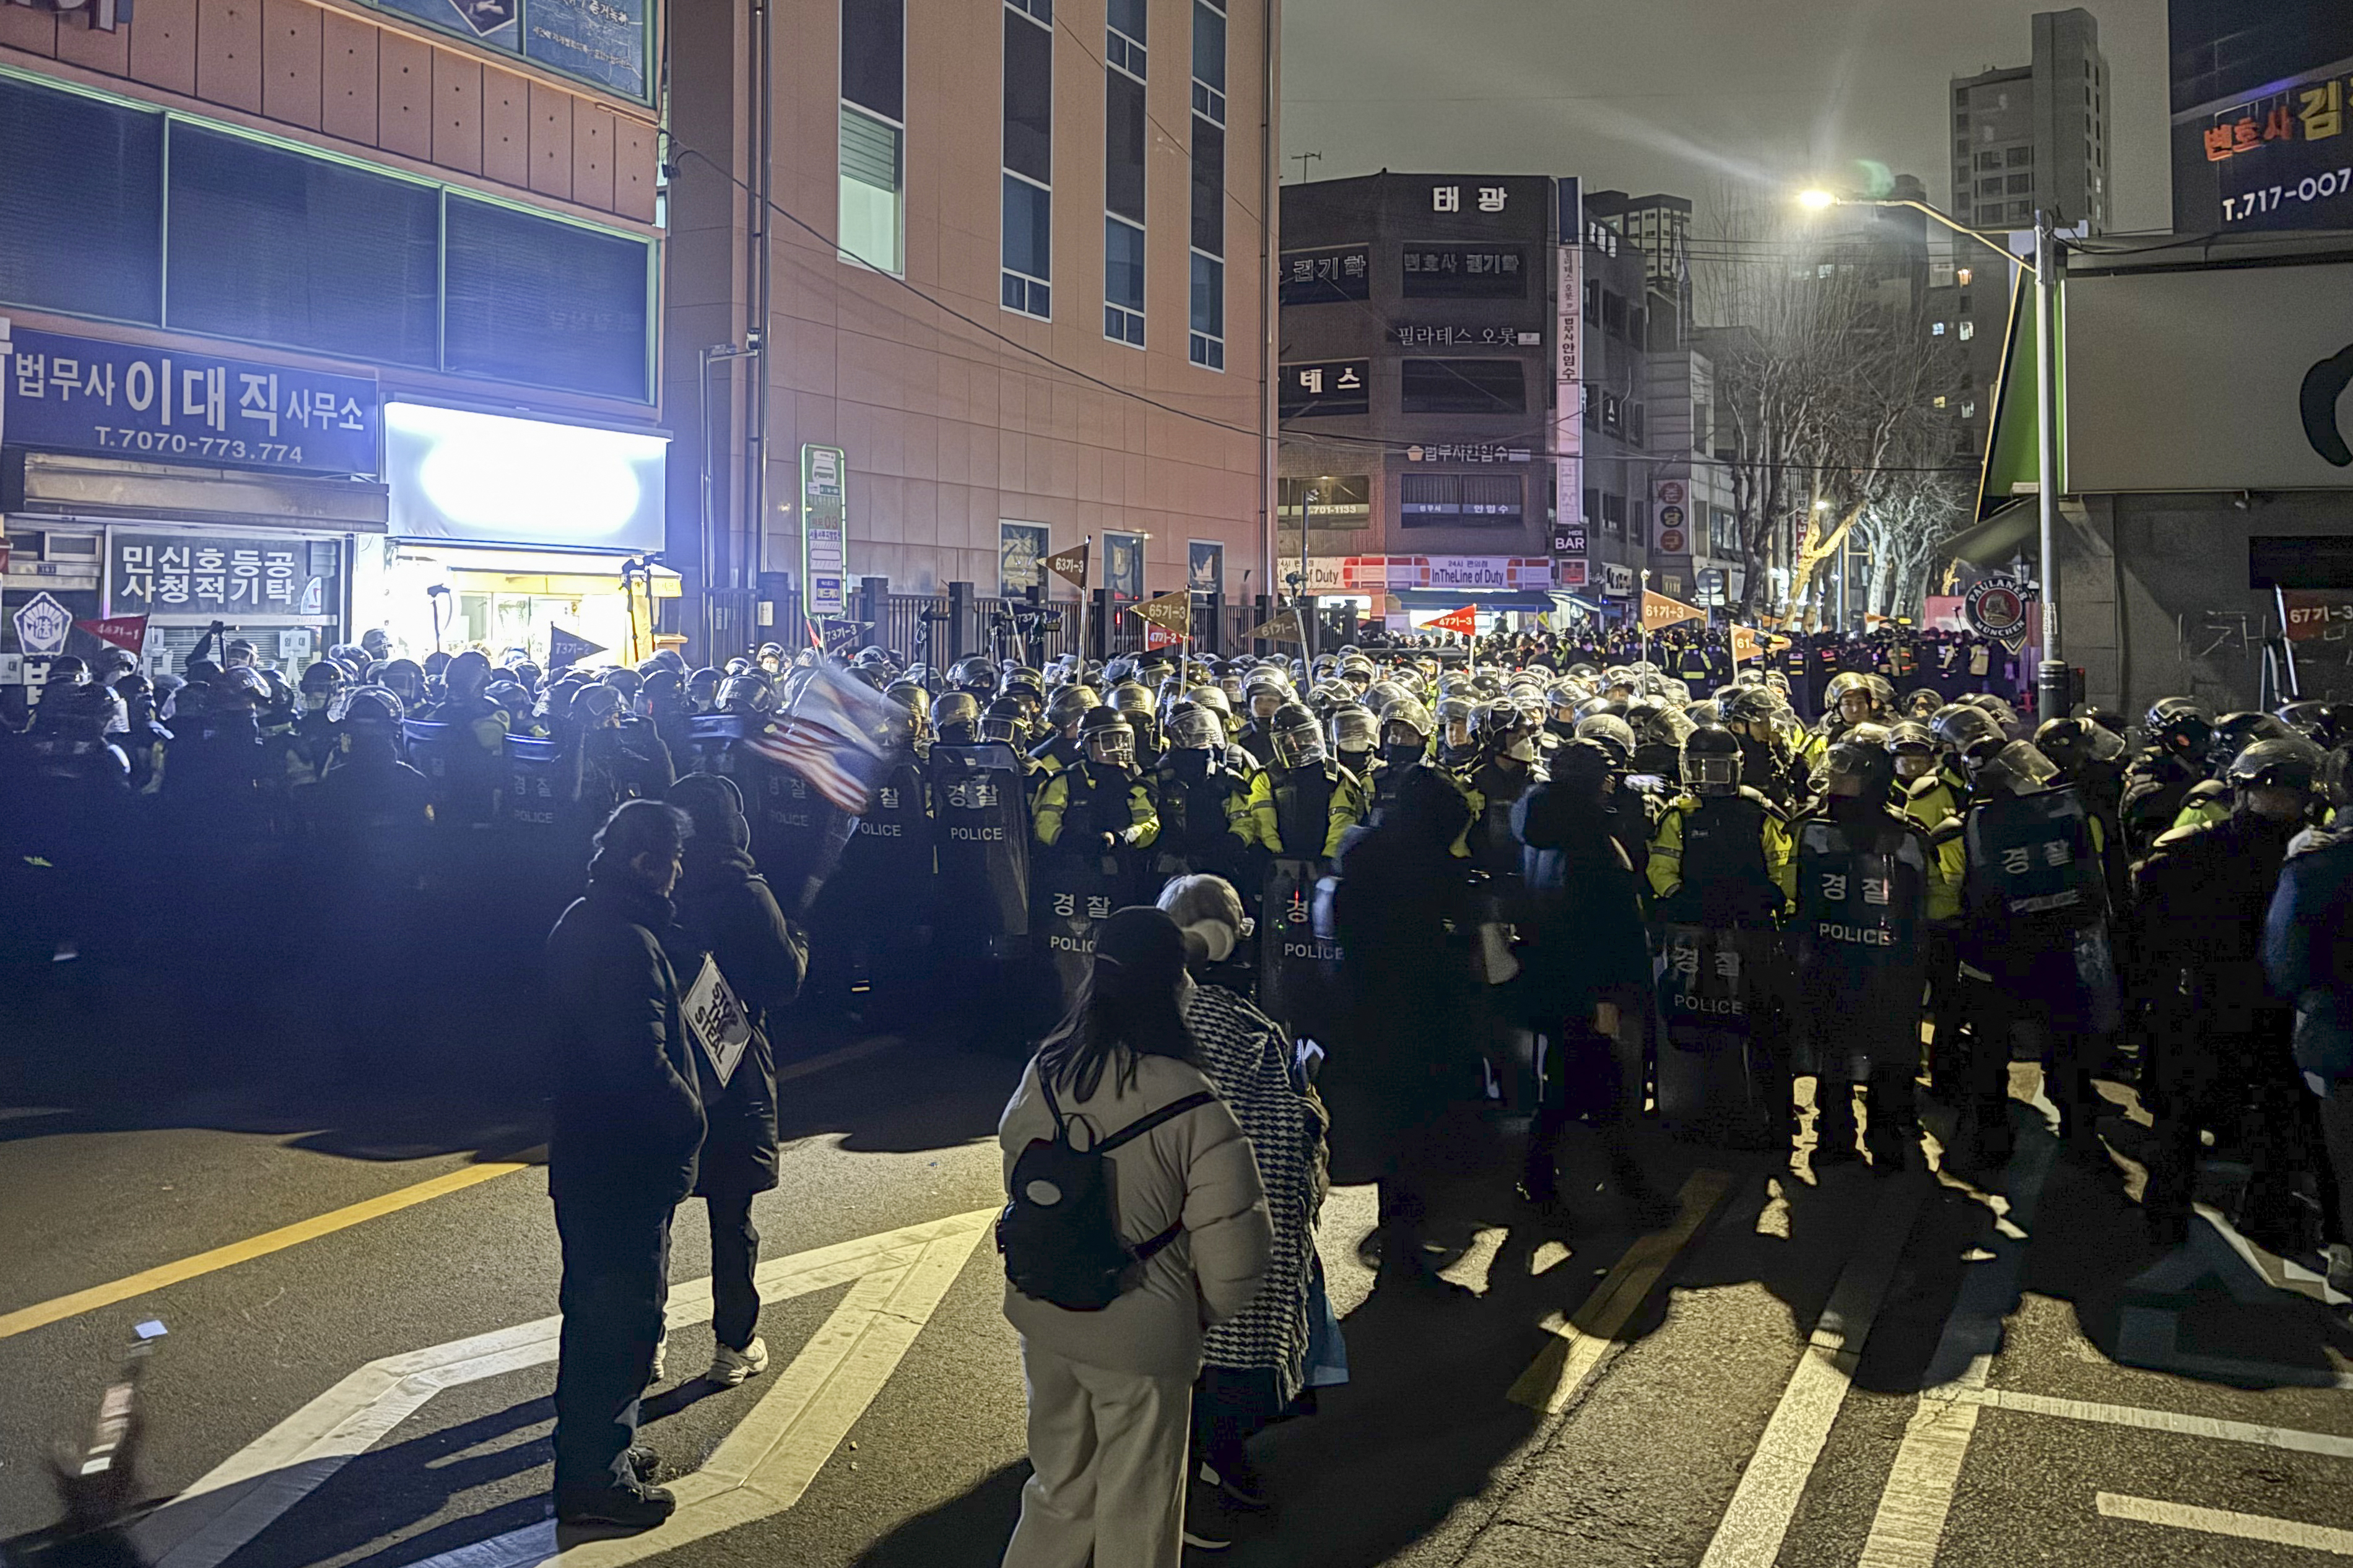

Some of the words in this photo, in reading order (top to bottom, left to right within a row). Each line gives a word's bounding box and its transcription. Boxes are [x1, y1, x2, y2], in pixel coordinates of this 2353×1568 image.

[2299, 79, 2353, 141] 김
[1433, 186, 1508, 212] 태광
[2222, 168, 2352, 221] T.717-007
[1398, 326, 1473, 346] 필라테스
[1477, 327, 1517, 347] 오롯
[1300, 368, 1361, 393] 테스
[15, 353, 115, 406] 법무사
[125, 359, 278, 437] 이대직
[285, 389, 365, 431] 사무소
[95, 426, 303, 464] T.7070-773.774
[1308, 505, 1357, 515] .701-1133
[1555, 537, 1585, 550] BAR
[1448, 560, 1463, 568] 24시
[1315, 569, 1339, 585] Duty
[1432, 570, 1472, 584] InTheLine
[1474, 570, 1484, 584] of
[1485, 570, 1504, 587] Duty
[1968, 579, 2029, 602] PAULANER
[1438, 616, 1473, 627] 47기-3
[1645, 604, 1685, 619] 61기-3
[947, 784, 999, 807] 경찰
[950, 827, 1003, 841] POLICE
[1053, 891, 1111, 919] 경찰
[1050, 935, 1096, 955] POLIC
[1819, 922, 1892, 946] POLICE
[1284, 942, 1345, 961] POLICE
[1673, 993, 1744, 1016] POLICE
[694, 1005, 725, 1064] STEAL
